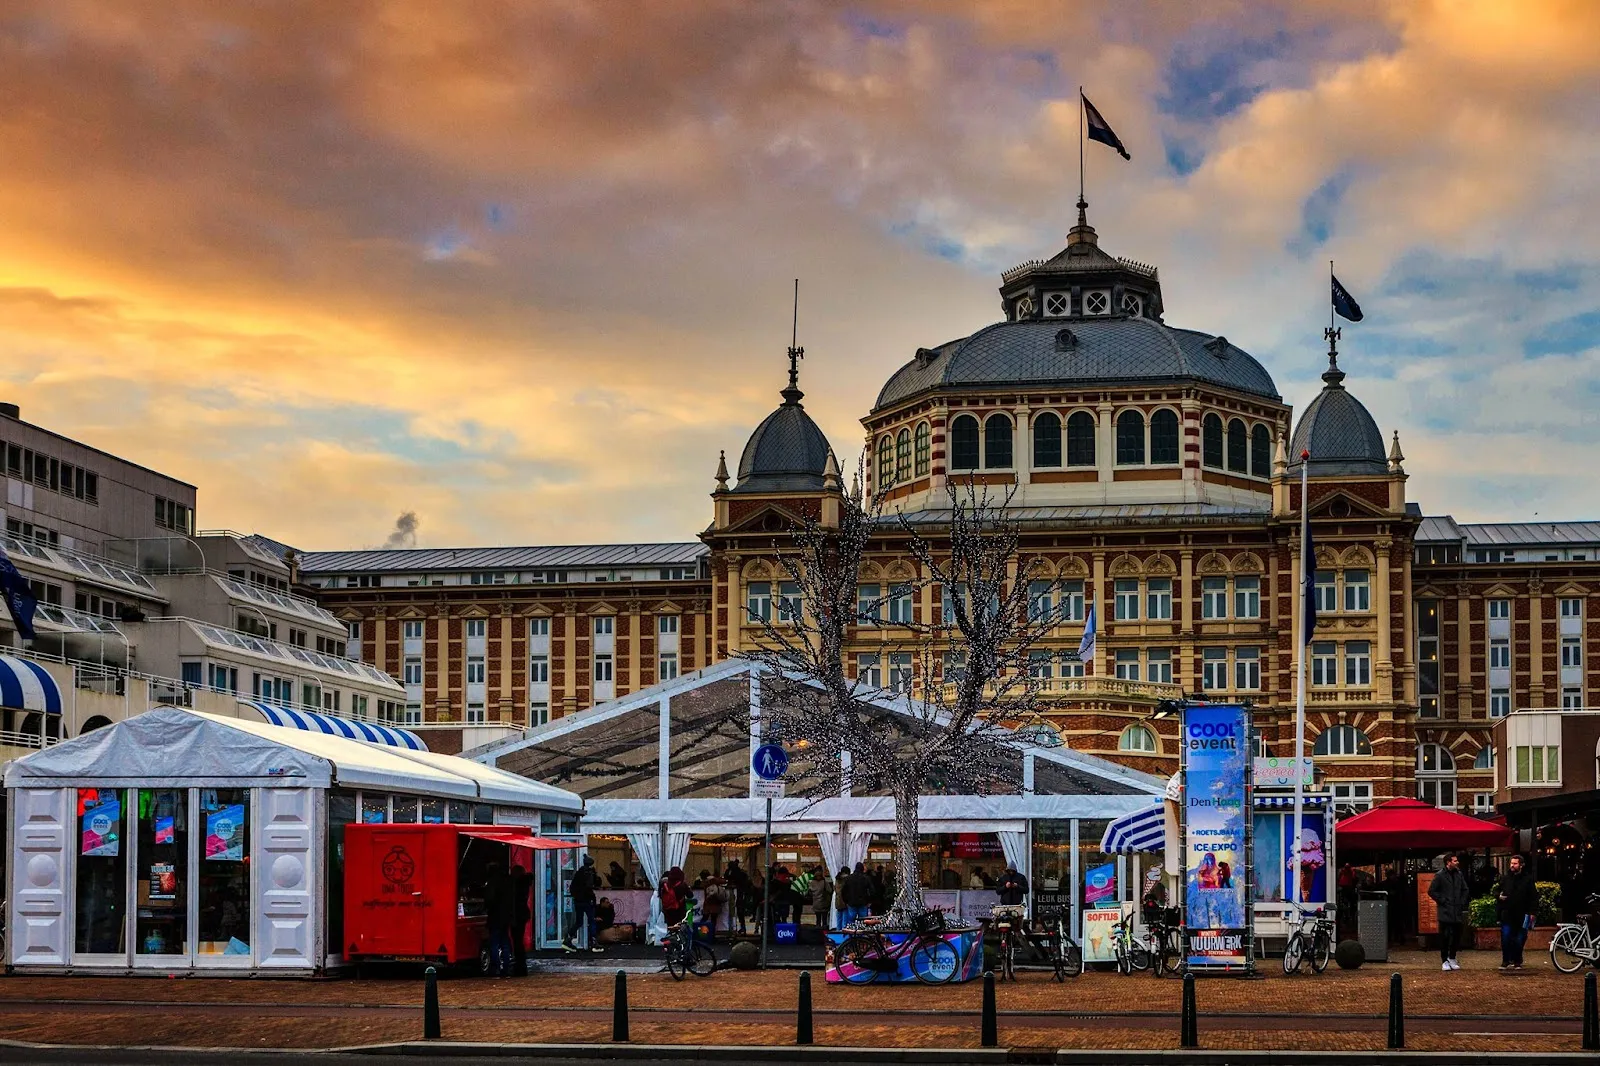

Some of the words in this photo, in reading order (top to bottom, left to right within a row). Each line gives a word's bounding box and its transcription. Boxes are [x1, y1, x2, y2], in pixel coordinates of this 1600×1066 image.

[1190, 723, 1235, 737] COOL
[1190, 738, 1236, 750] event
[1190, 798, 1211, 806] Den
[1212, 797, 1241, 808] Haag
[1193, 843, 1209, 852] ICE
[1211, 843, 1238, 852] EXPO
[1037, 894, 1056, 903] LEUK
[1190, 935, 1242, 951] VUURWERK
